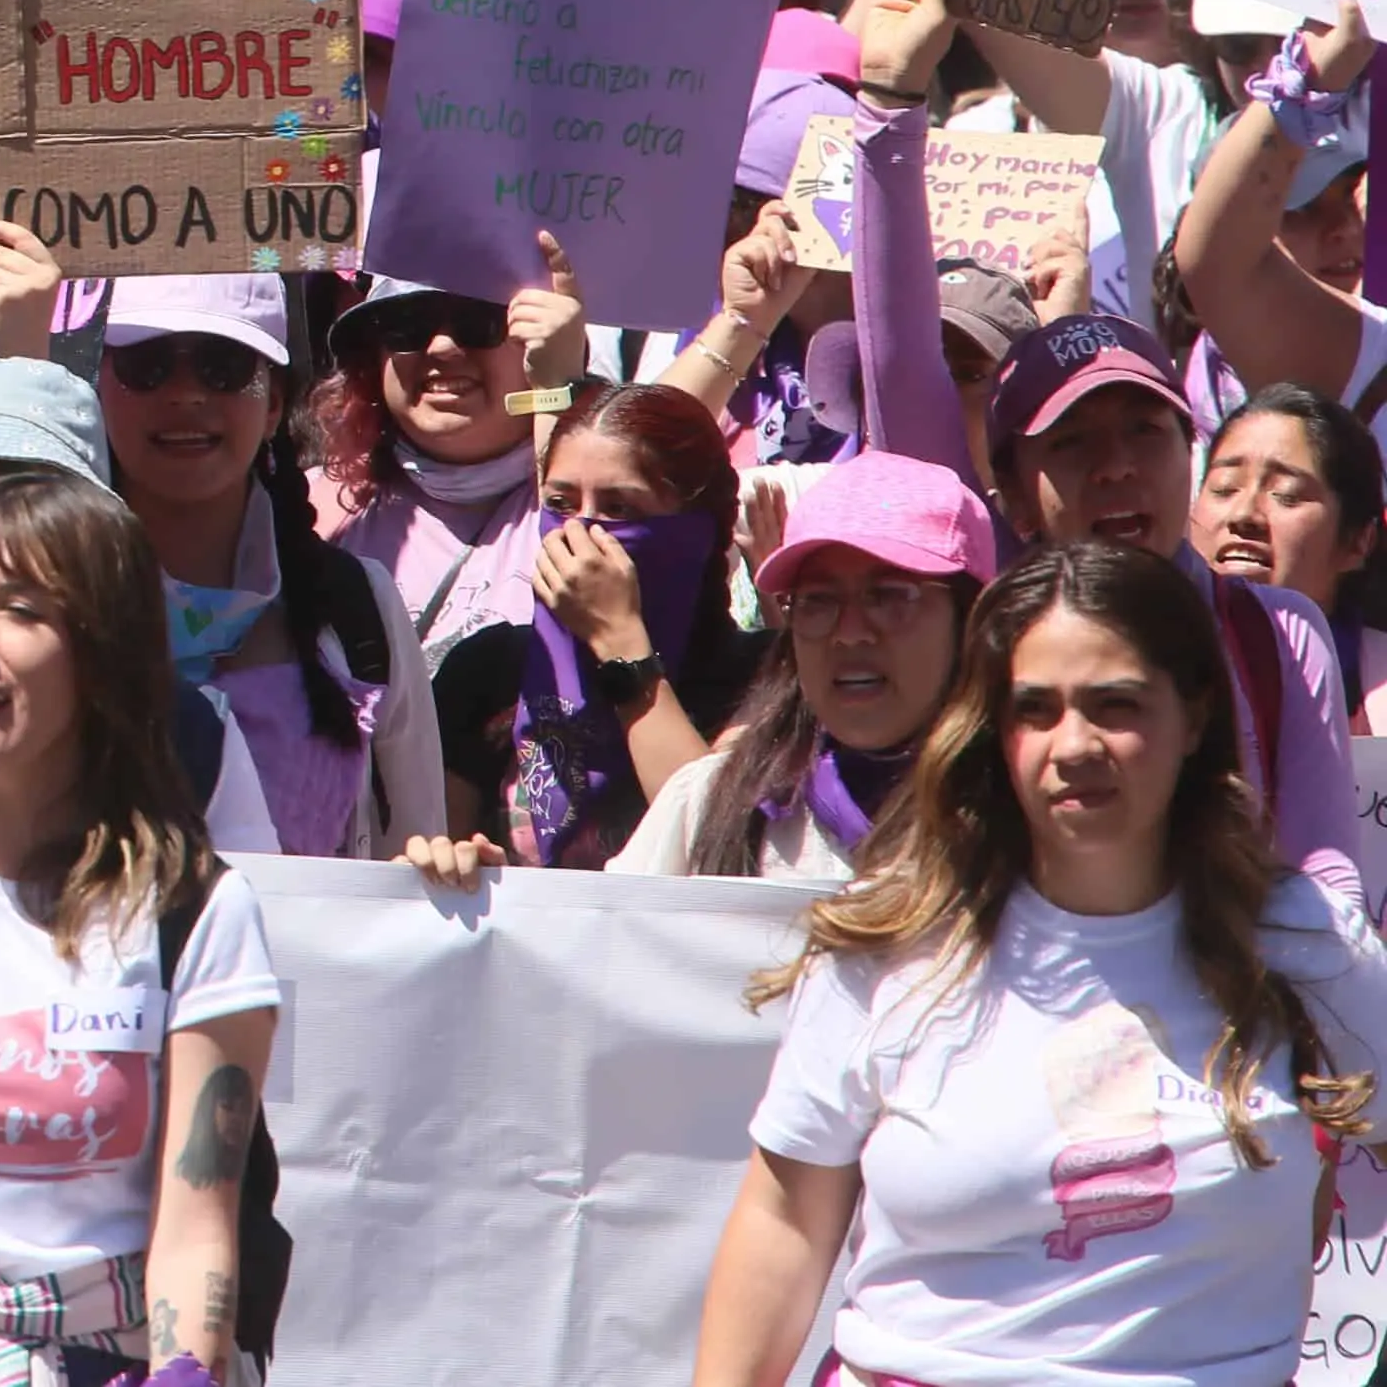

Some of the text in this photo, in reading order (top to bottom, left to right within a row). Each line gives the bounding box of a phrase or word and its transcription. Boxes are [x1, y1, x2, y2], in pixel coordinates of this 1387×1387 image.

[557, 1, 579, 30] a
[514, 35, 707, 93] fetichizar mi
[552, 111, 605, 144] con
[622, 121, 686, 158] otra
[926, 142, 990, 173] Hoy
[494, 172, 627, 226] MUJER
[1023, 179, 1081, 199] por
[3, 184, 163, 251] COMO
[173, 184, 219, 251] A
[242, 182, 358, 248] UNO
[982, 206, 1059, 230] por
[1052, 332, 1121, 368] MOM
[49, 1001, 147, 1034] Dani
[1156, 1074, 1263, 1112] Diaa
